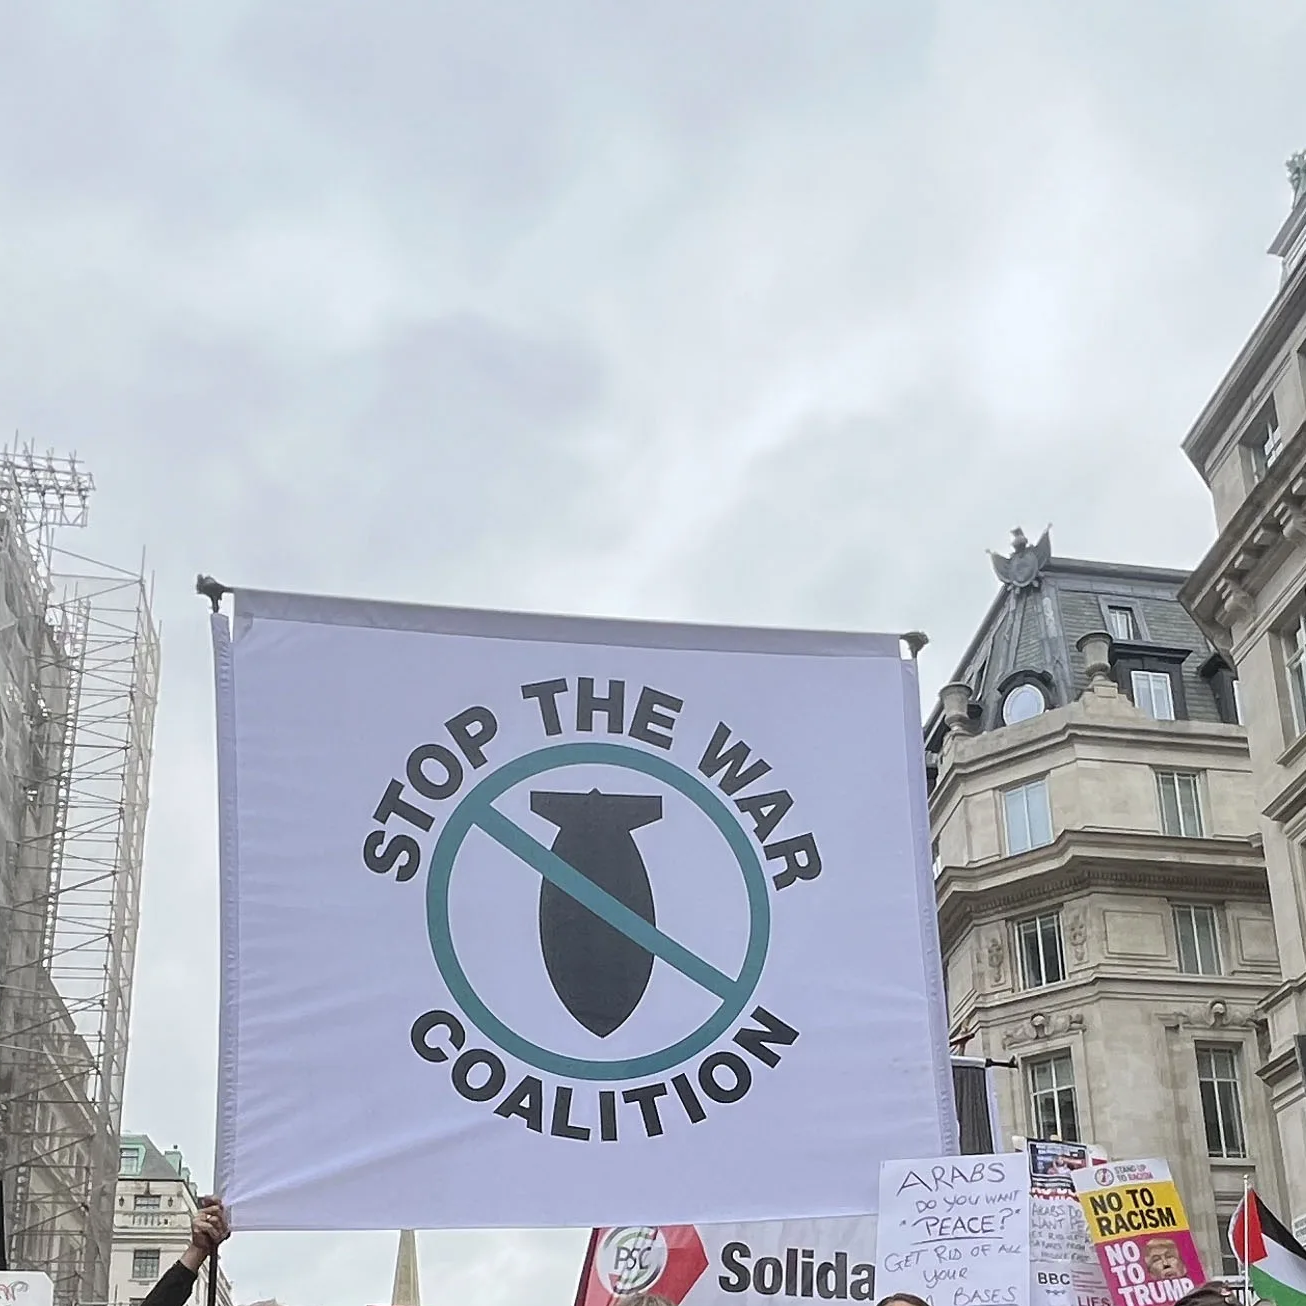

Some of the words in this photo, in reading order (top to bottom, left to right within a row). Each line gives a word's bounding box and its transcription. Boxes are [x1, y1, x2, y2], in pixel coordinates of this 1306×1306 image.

[363, 705, 499, 882] STOP
[521, 676, 684, 750] THE
[698, 721, 823, 890] WAR
[410, 1004, 801, 1142] COALITION
[896, 1162, 1006, 1197] ARABS
[915, 1199, 937, 1213] DO
[943, 1195, 980, 1213] YOU
[985, 1189, 1023, 1205] WANT
[1089, 1192, 1123, 1216] NO
[1126, 1187, 1155, 1209] TO
[1096, 1207, 1177, 1237] RACISM
[884, 1248, 929, 1273] GET
[934, 1244, 962, 1264] RID
[970, 1244, 992, 1257] OF
[1104, 1240, 1141, 1267] NO
[718, 1241, 876, 1301] Solida
[1038, 1272, 1071, 1285] BBC
[1111, 1262, 1145, 1288] TO
[953, 1286, 1017, 1306] BASES
